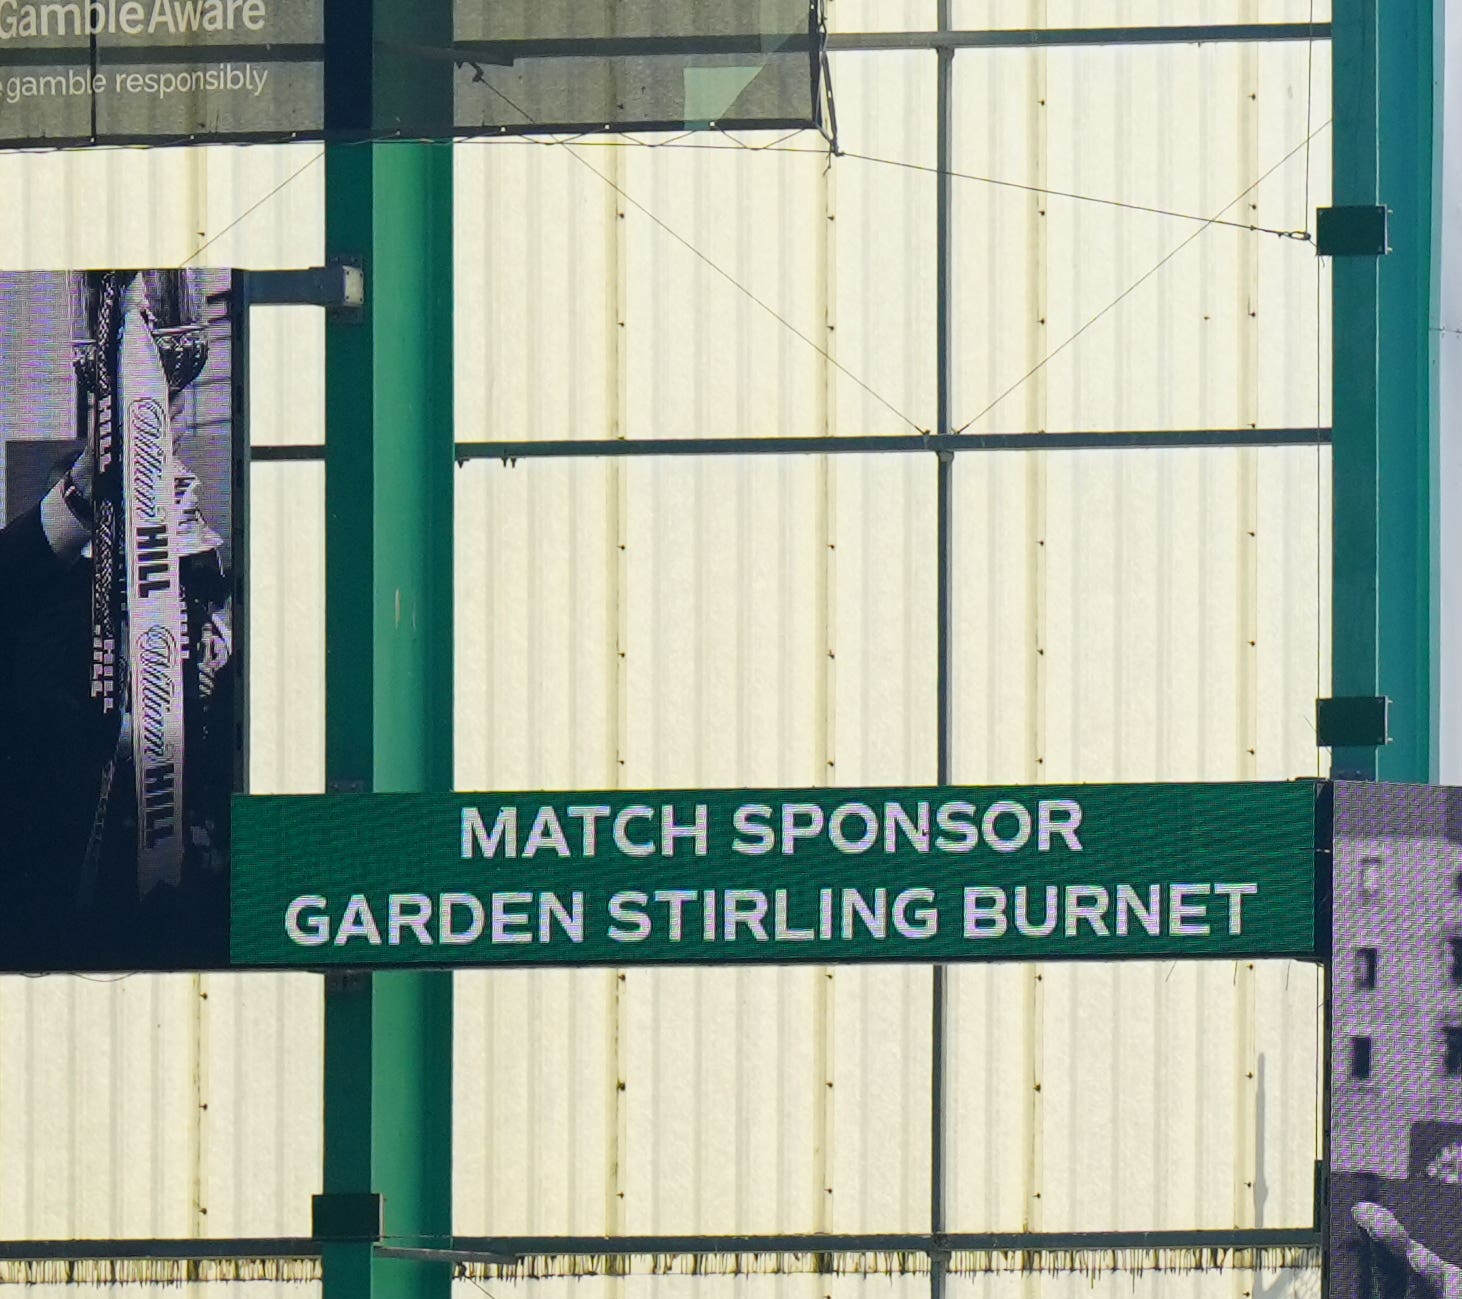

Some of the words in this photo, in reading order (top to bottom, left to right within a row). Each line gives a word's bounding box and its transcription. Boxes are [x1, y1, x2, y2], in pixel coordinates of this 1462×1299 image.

[0, 0, 266, 40] GambleAware
[6, 69, 107, 104] gamble
[115, 62, 269, 99] responsibly
[136, 526, 170, 599] HILL
[143, 761, 177, 849] HILL
[460, 803, 710, 862] MATCH
[732, 798, 1084, 856] SPONSOR
[283, 892, 585, 949] GARDEN
[606, 887, 940, 944] STIRLING
[963, 881, 1259, 940] BURNET
